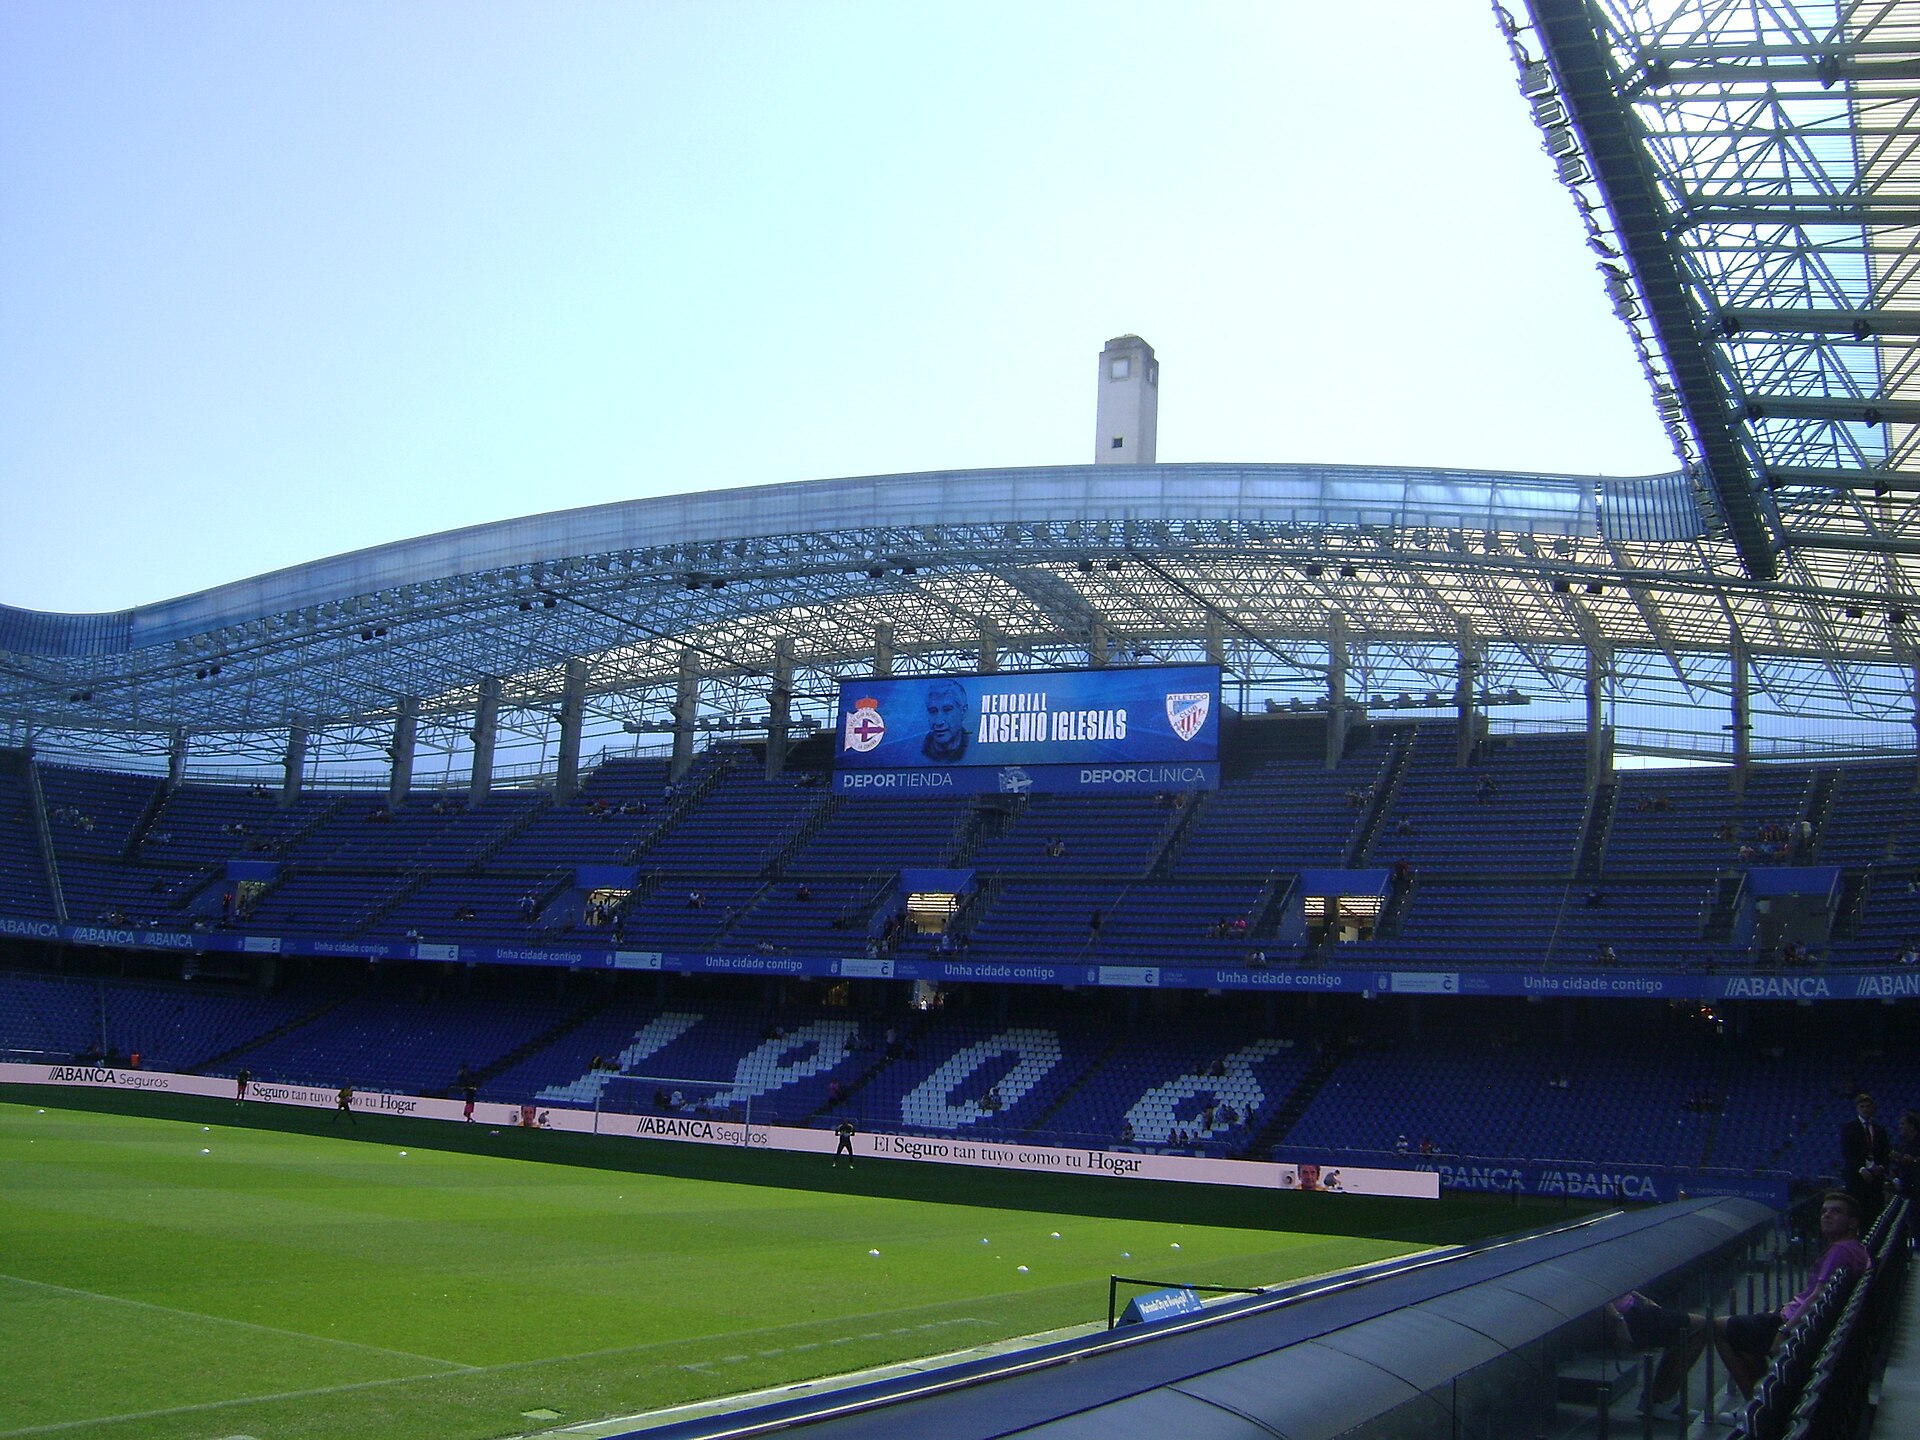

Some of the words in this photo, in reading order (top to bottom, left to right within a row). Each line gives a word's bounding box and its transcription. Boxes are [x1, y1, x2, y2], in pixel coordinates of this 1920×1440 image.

[982, 693, 1047, 713] MEMORIAL
[978, 711, 1047, 742] ARSENIO
[1051, 709, 1127, 740] IGLESIAS
[844, 773, 953, 787] DEPORTIENDA
[497, 949, 518, 959] Unha
[520, 949, 548, 961] cidade
[550, 950, 582, 964] contigo
[705, 956, 730, 968] Unha
[732, 957, 764, 969] cidade
[766, 958, 803, 972] contigo
[944, 965, 973, 976] Unha
[975, 965, 1011, 977] cidade
[1014, 966, 1055, 980] contigo
[1216, 971, 1248, 983] Unha
[1251, 971, 1292, 984] cidade
[1295, 972, 1341, 988] contigo
[1523, 976, 1558, 989] Unha
[1562, 976, 1607, 990] cidade
[1611, 976, 1663, 994] contigo
[119, 1073, 169, 1088] Seguros
[252, 1083, 289, 1103] Seguro
[291, 1089, 307, 1100] tan
[310, 1091, 332, 1105] tuyo
[365, 1096, 377, 1107] tu
[380, 1095, 417, 1114] Hogar
[716, 1126, 768, 1144] Seguros
[874, 1136, 889, 1152] El
[893, 1137, 949, 1159] Seguro
[953, 1145, 977, 1160] tan
[981, 1147, 1014, 1165] tuyo
[1018, 1152, 1061, 1166] como
[1066, 1154, 1082, 1168] tu
[1087, 1152, 1142, 1175] Hogar
